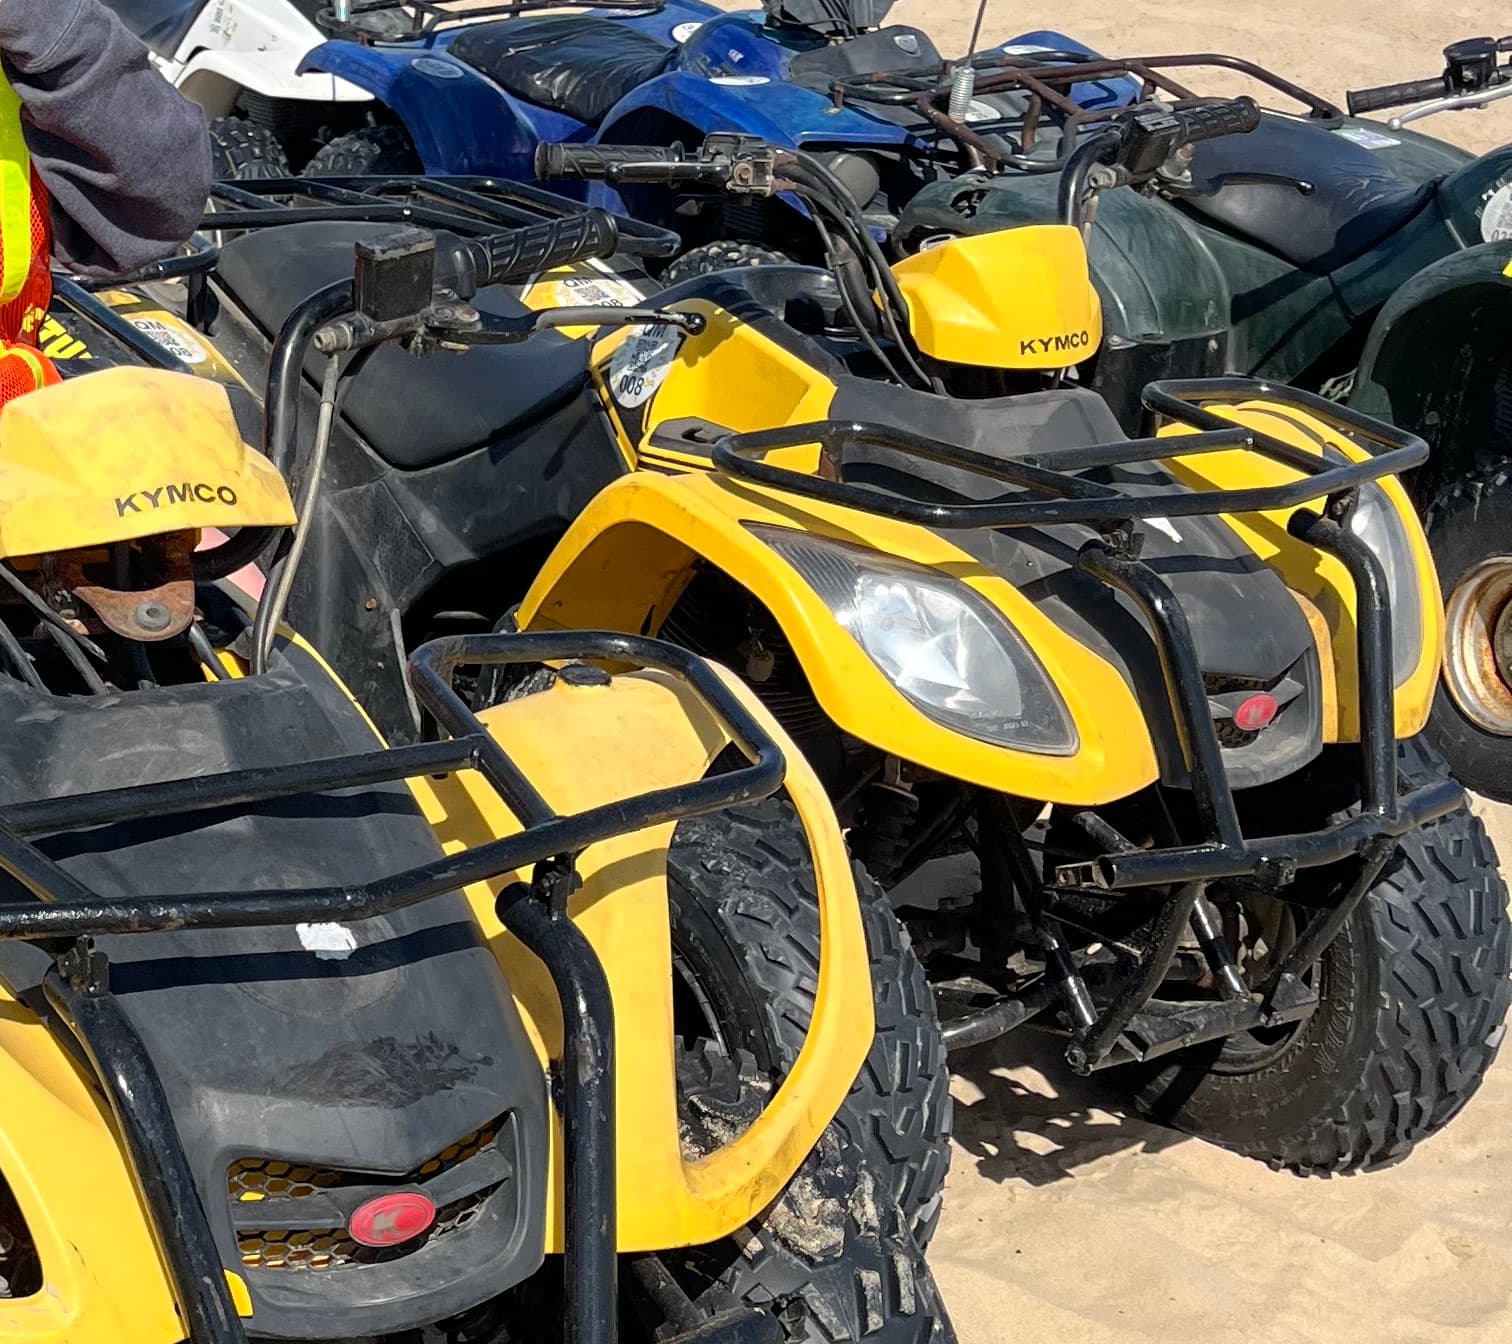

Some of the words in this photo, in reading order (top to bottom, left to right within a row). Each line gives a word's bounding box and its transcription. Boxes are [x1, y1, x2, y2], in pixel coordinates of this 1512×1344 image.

[1020, 330, 1089, 356] KYMCO
[619, 374, 645, 396] 008
[114, 482, 238, 517] KYMCO
